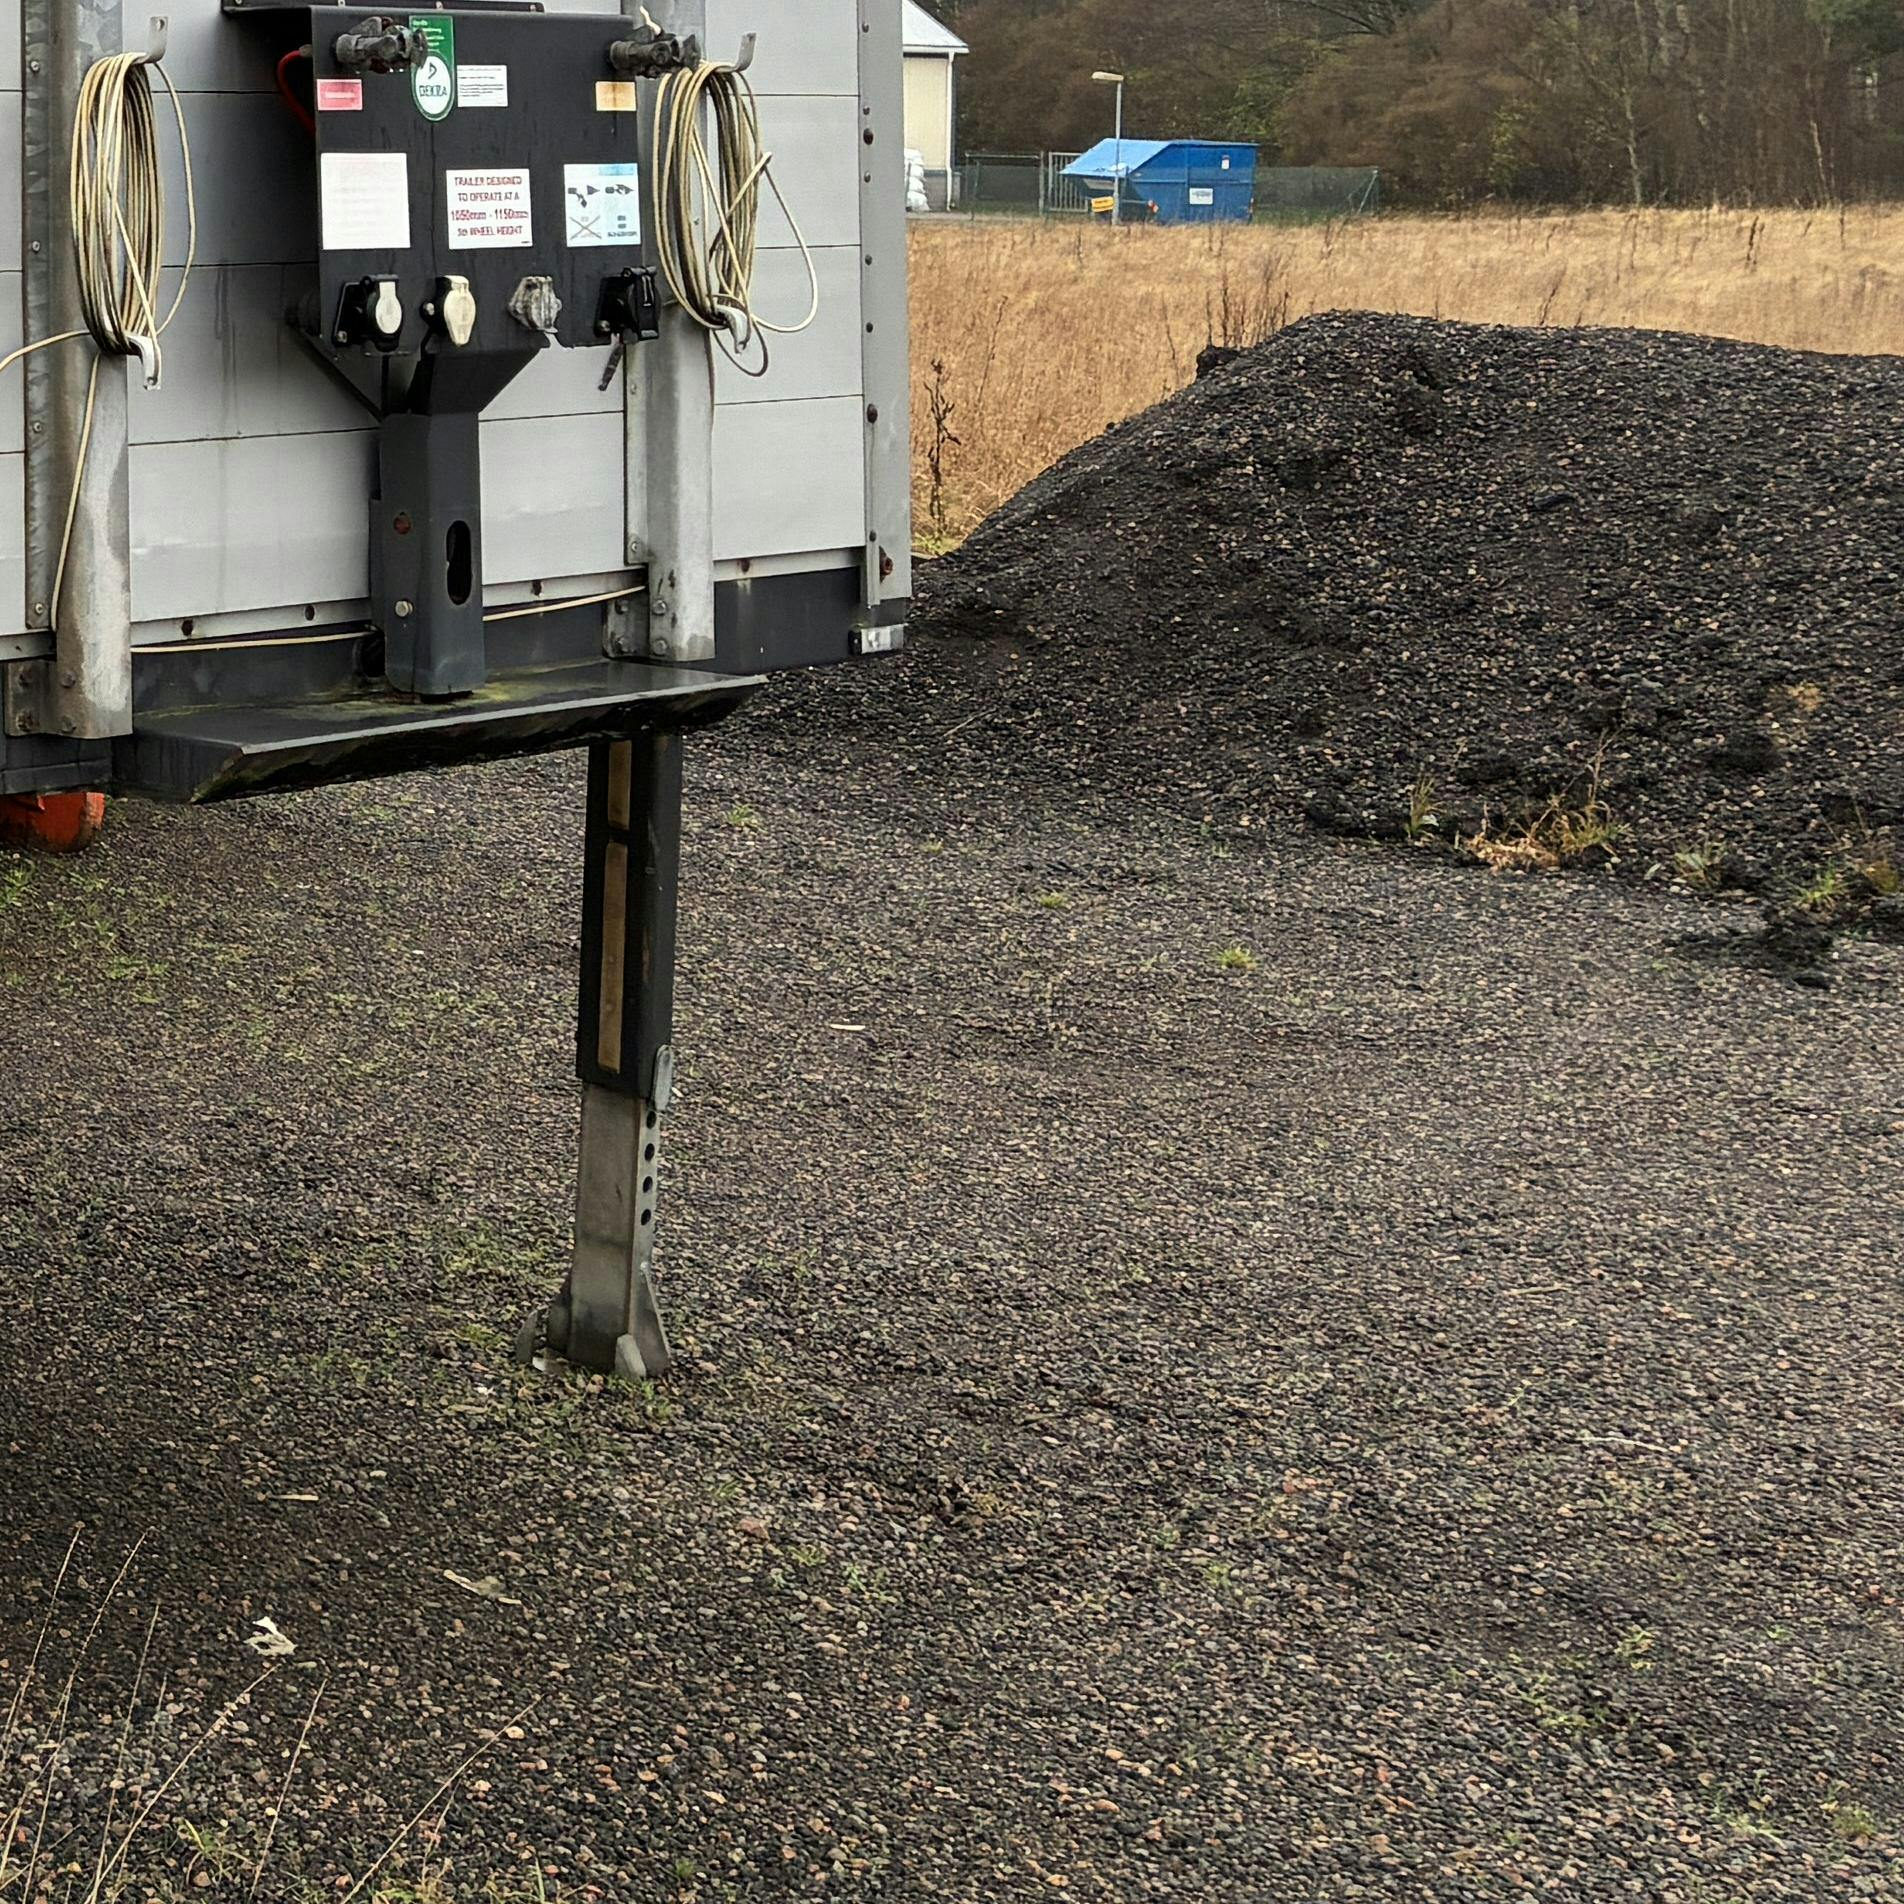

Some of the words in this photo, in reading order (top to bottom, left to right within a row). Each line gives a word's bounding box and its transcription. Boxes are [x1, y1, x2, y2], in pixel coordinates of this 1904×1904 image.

[454, 177, 484, 186] TRAILER
[486, 176, 522, 185] DESIGNED
[458, 192, 468, 201] TO
[470, 192, 502, 201] OPERATE
[504, 192, 512, 200] AT
[514, 192, 520, 200] A
[470, 226, 495, 236] WHEEL
[496, 225, 523, 235] HEIGHT
